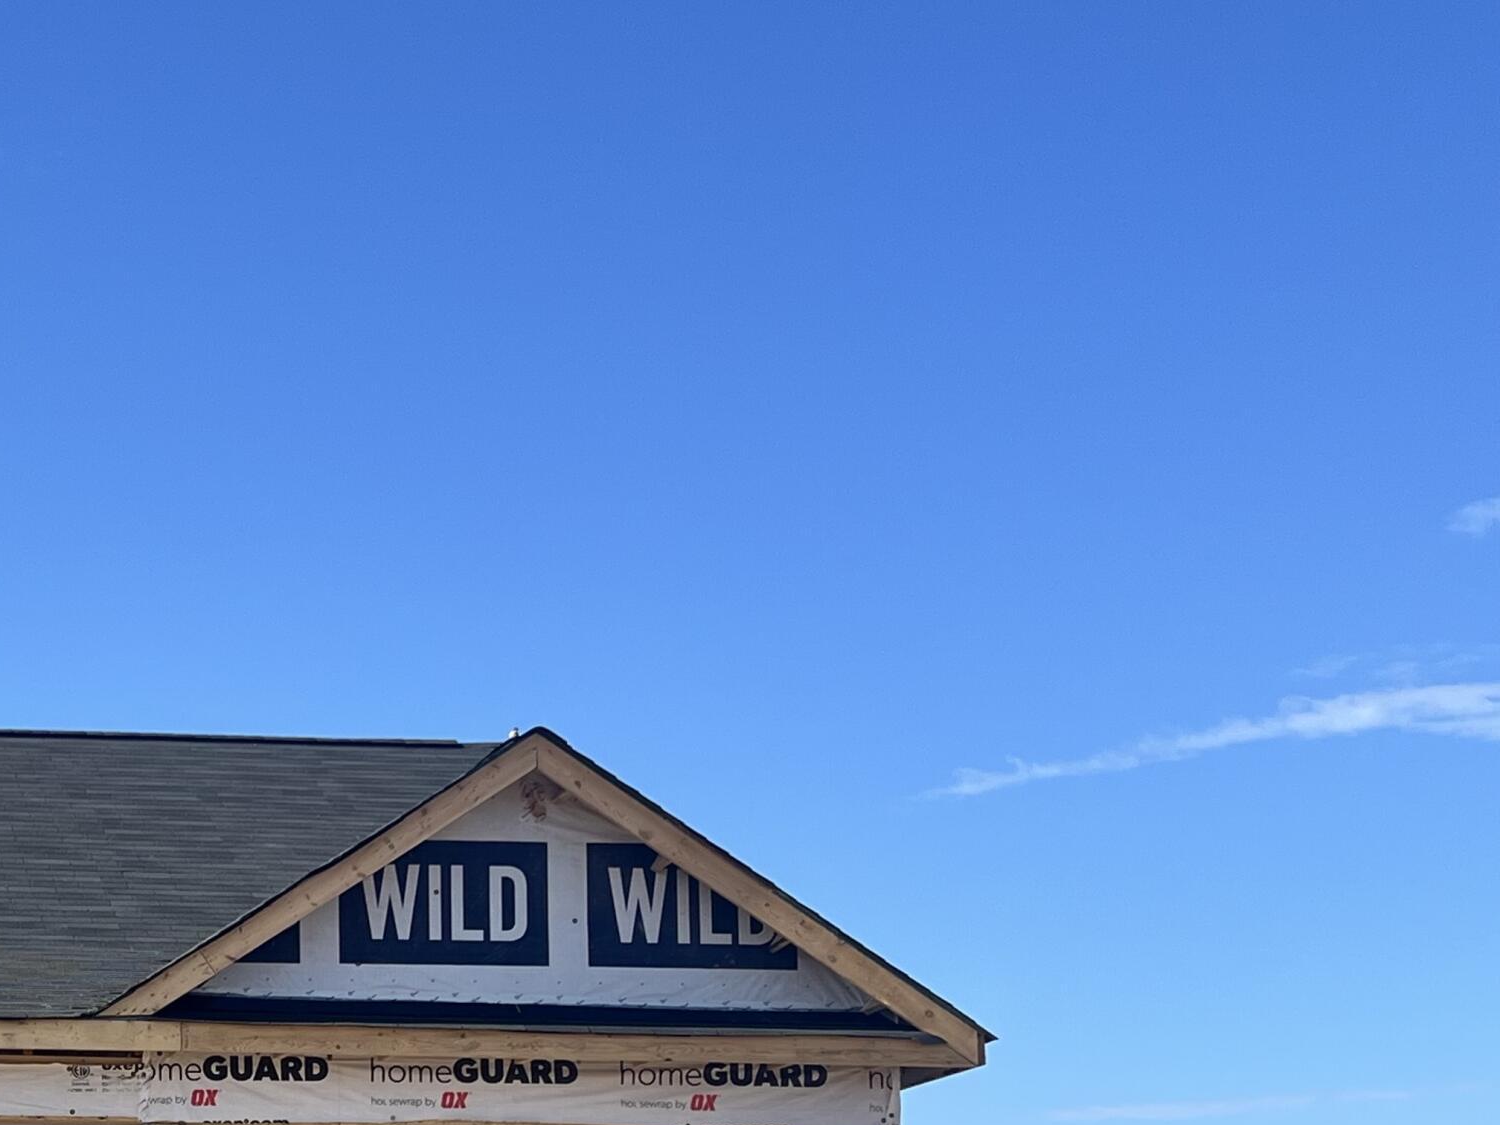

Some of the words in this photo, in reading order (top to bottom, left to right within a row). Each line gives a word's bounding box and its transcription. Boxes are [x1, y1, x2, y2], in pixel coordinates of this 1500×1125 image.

[362, 864, 528, 942] WILD
[370, 1057, 579, 1084] homeGUARD
[620, 1061, 828, 1089] homeGUARD
[175, 1095, 188, 1106] by
[190, 1088, 219, 1107] OX
[424, 1096, 437, 1109] by
[440, 1091, 469, 1109] OX
[675, 1100, 687, 1112] by
[690, 1093, 716, 1111] OX
